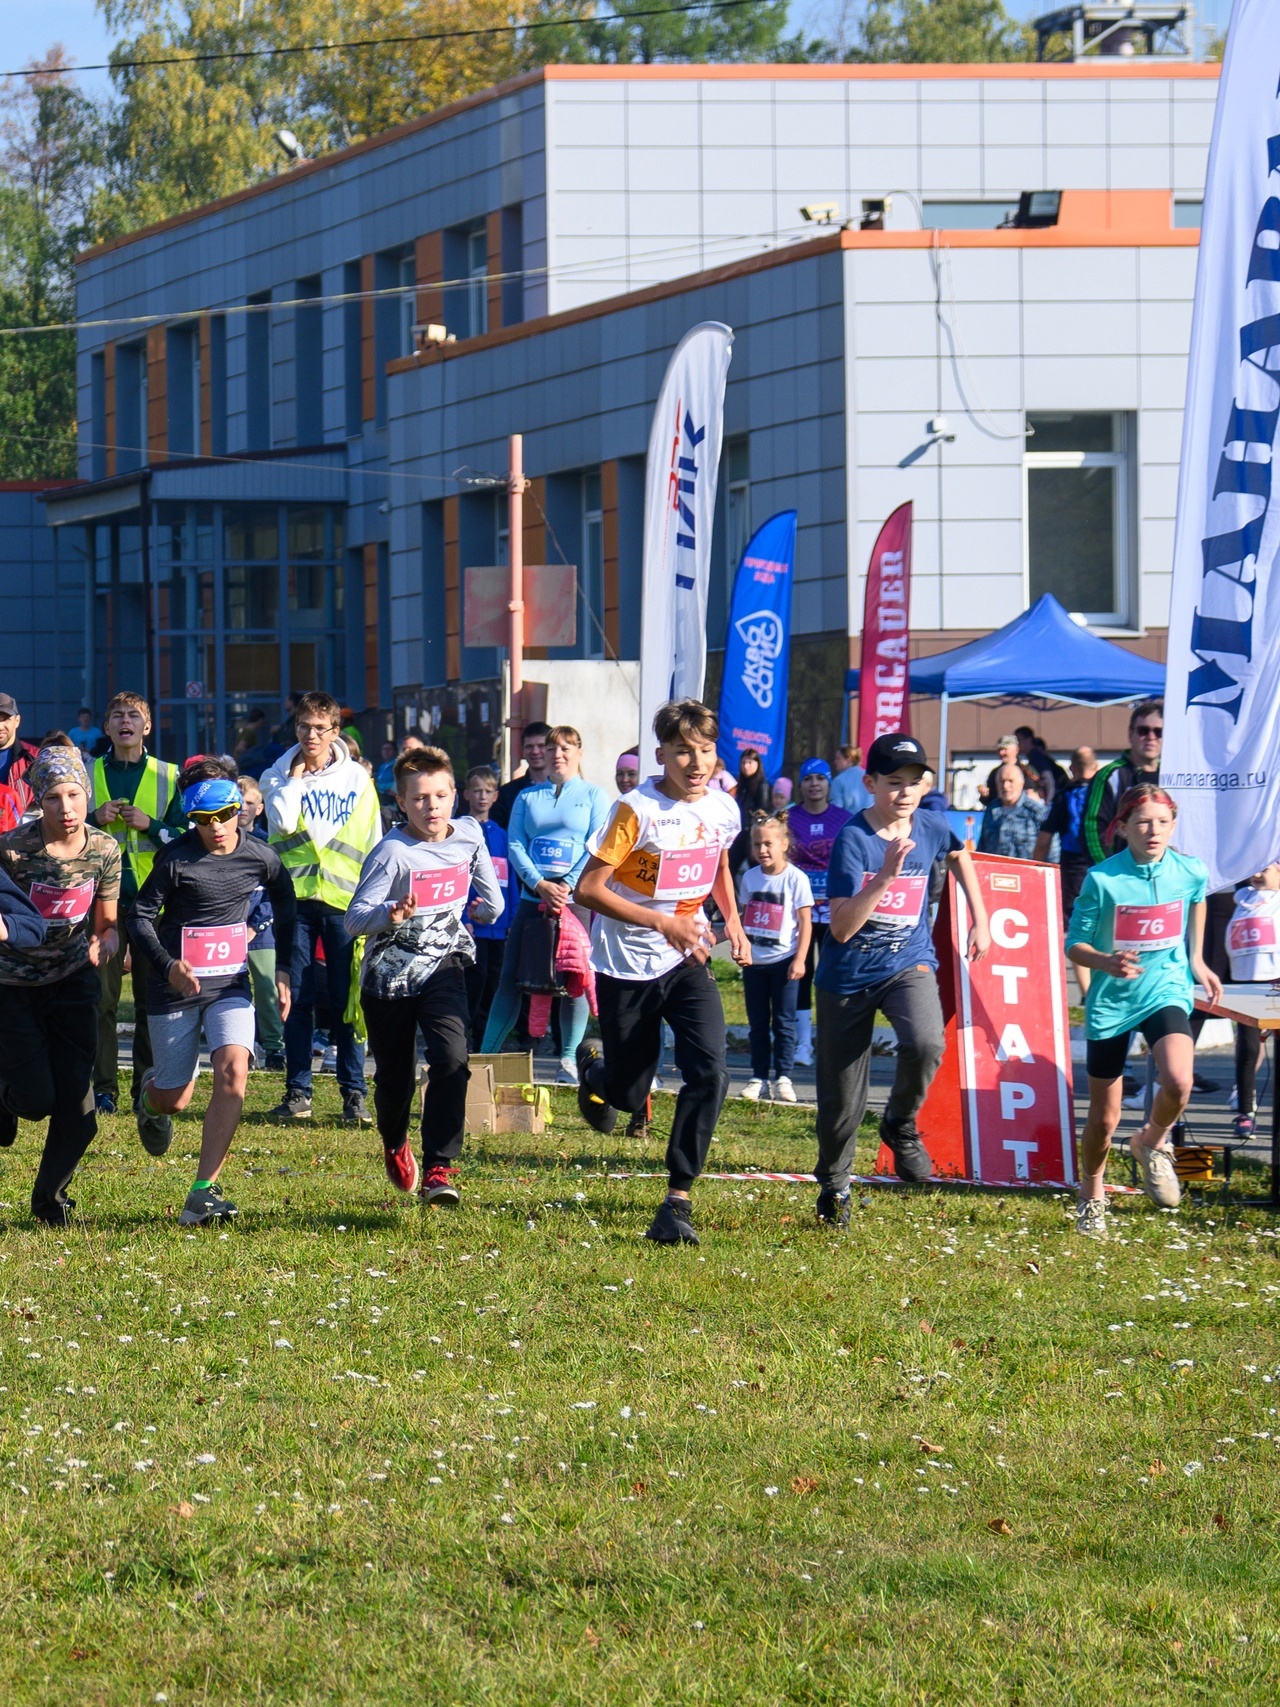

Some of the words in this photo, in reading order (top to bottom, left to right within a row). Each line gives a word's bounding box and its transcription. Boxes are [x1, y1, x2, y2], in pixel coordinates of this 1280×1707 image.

[540, 846, 563, 858] 198
[677, 863, 703, 882] 90
[431, 880, 455, 899] 75
[51, 899, 76, 914] 77
[879, 891, 907, 909] 93
[753, 911, 770, 925] 34
[1137, 918, 1165, 935] 76
[1241, 928, 1261, 943] 19
[204, 941, 230, 960] 79
[989, 907, 1039, 1179] СТАРТ
